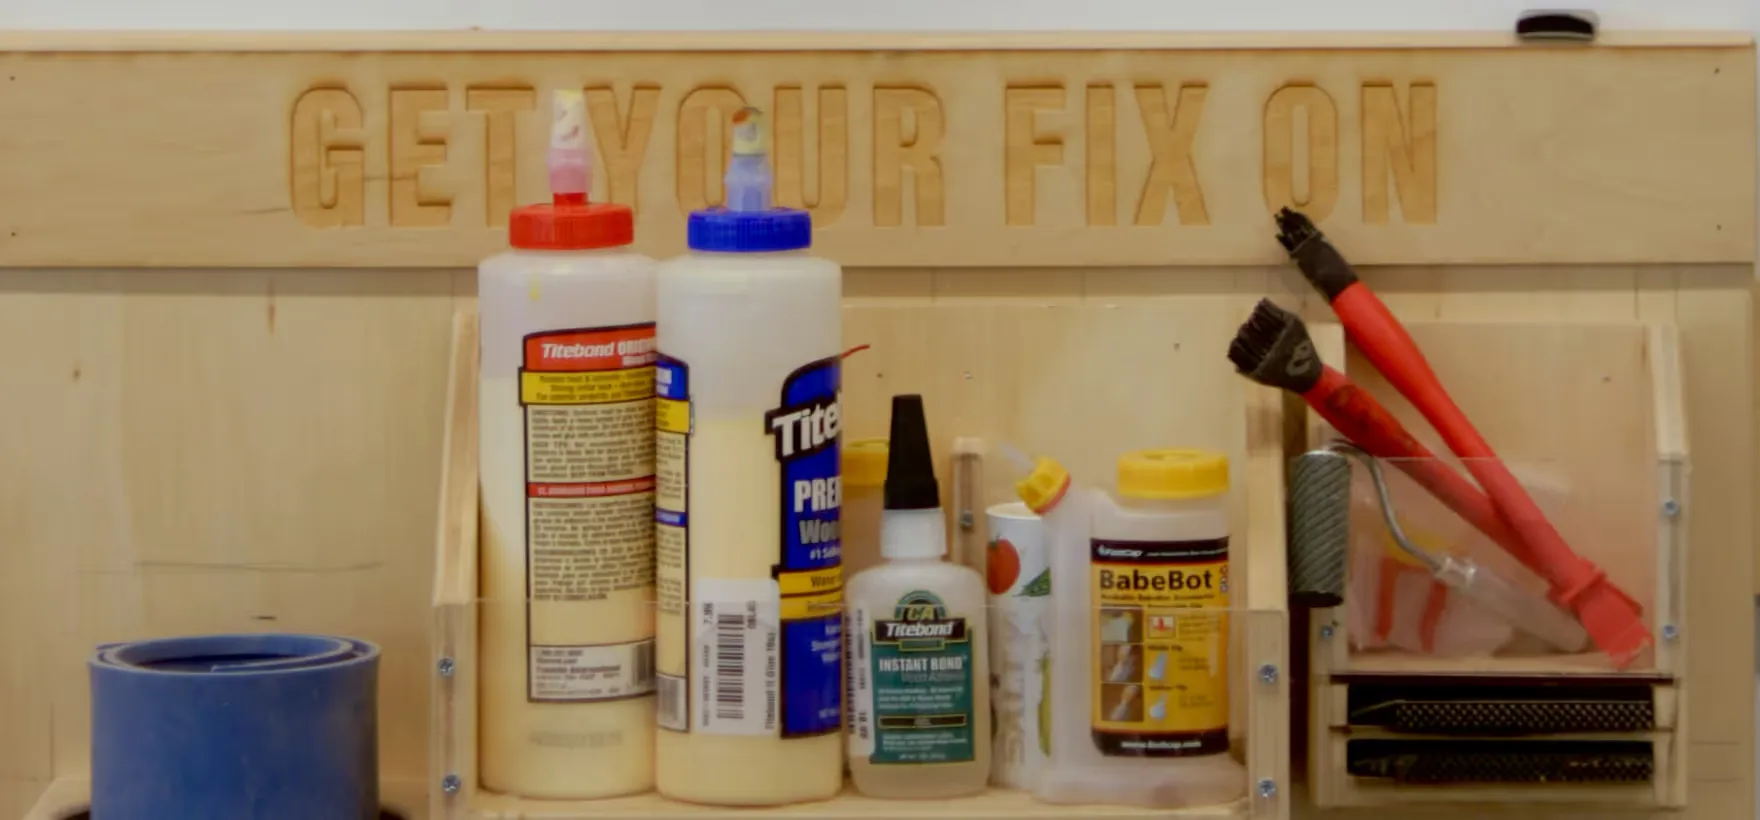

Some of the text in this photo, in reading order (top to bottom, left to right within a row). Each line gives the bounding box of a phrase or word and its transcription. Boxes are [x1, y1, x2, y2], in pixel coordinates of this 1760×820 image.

[290, 81, 1438, 227] GET YOUR FIX ON
[541, 342, 614, 359] Titebond
[1099, 569, 1213, 591] BabeBot
[885, 621, 954, 637] Titebond
[878, 657, 928, 673] INSTANT
